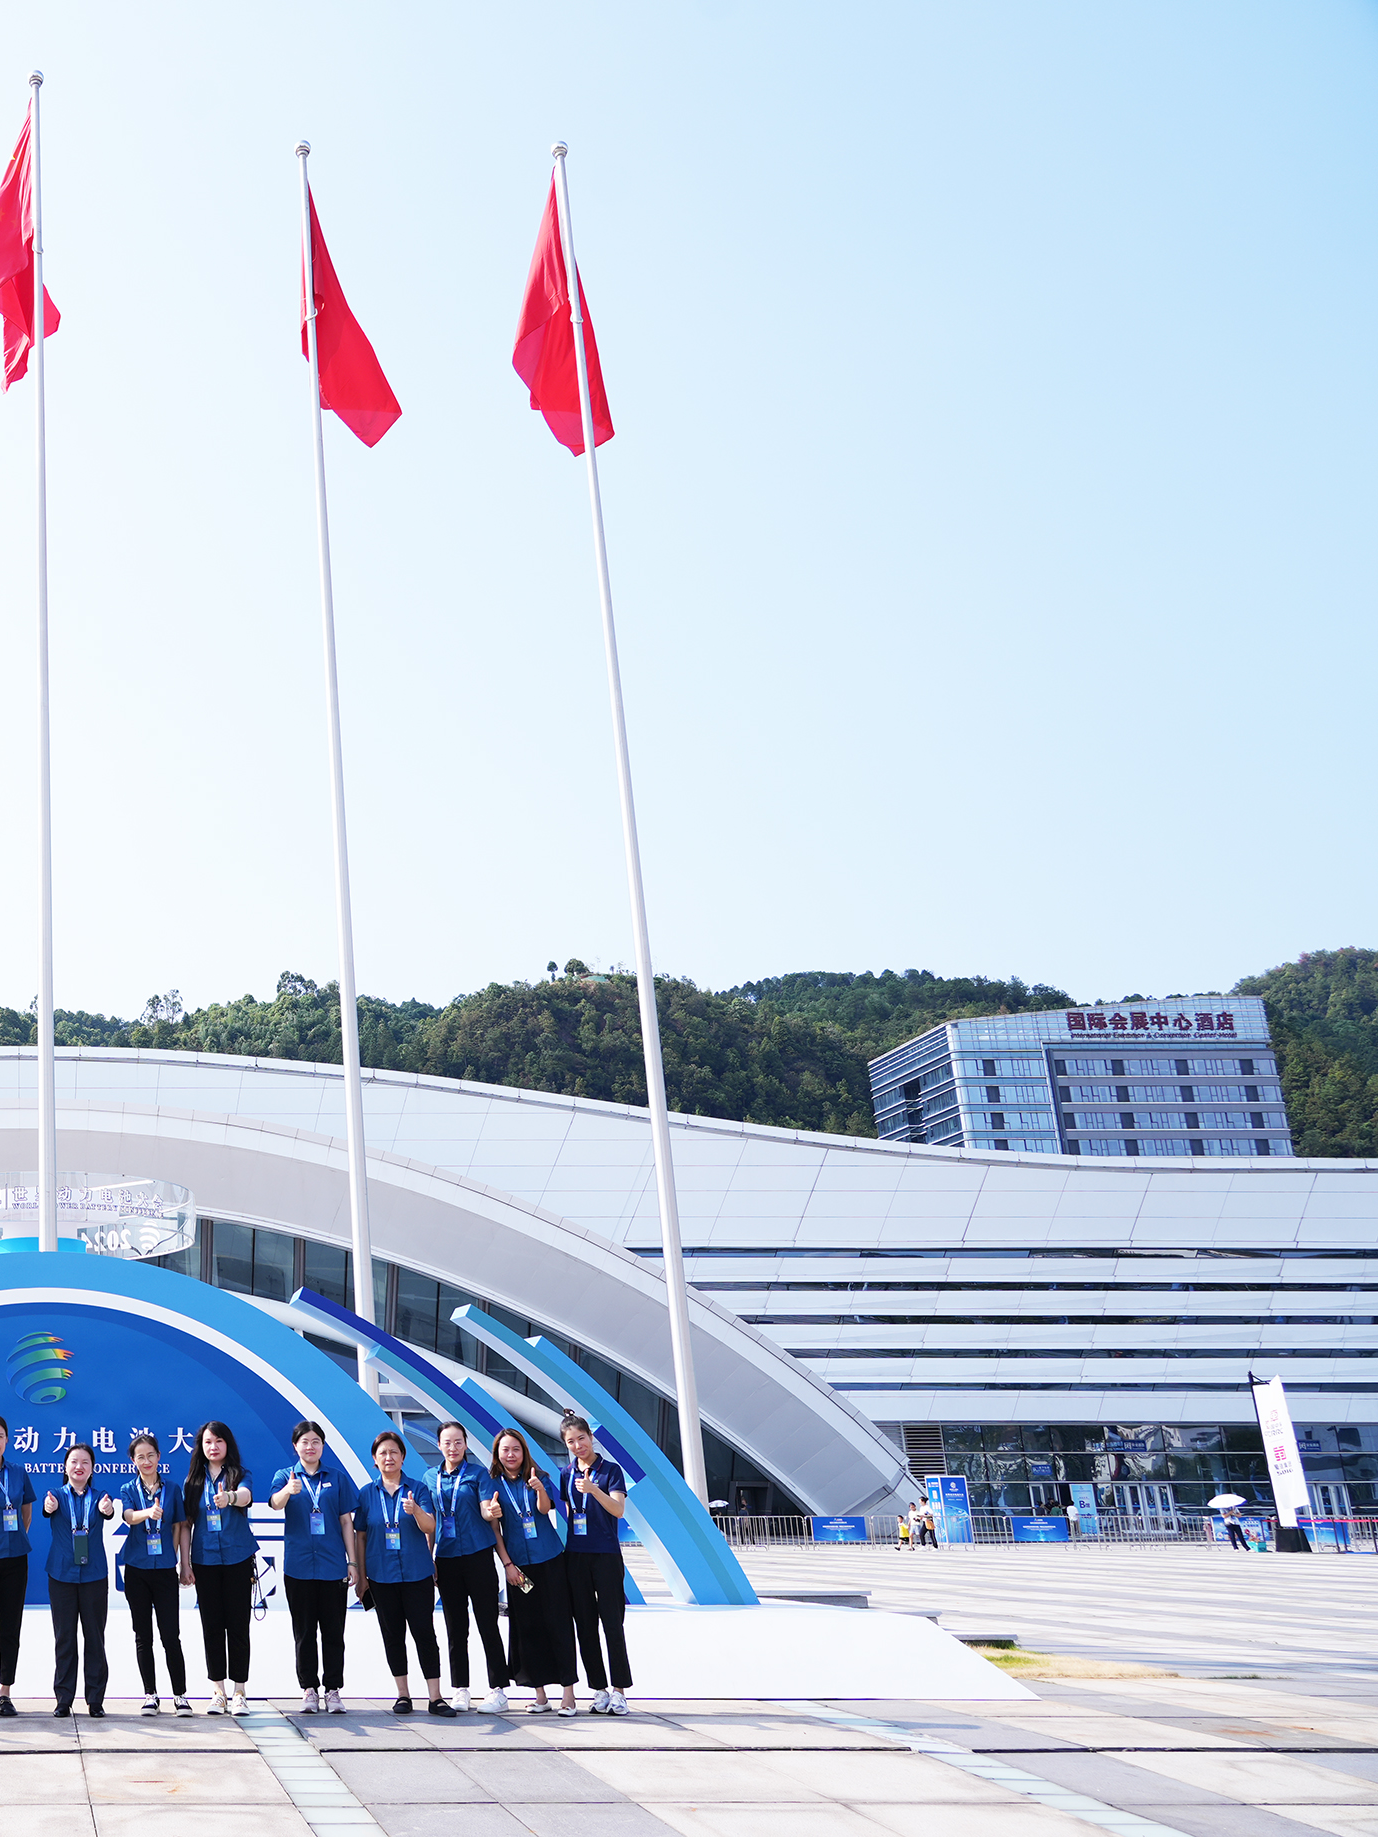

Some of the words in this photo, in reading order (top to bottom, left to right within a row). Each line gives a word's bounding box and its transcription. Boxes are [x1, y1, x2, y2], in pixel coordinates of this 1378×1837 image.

[1066, 1011, 1235, 1031] 国际会展中心酒店
[24, 1462, 65, 1474] BATTE
